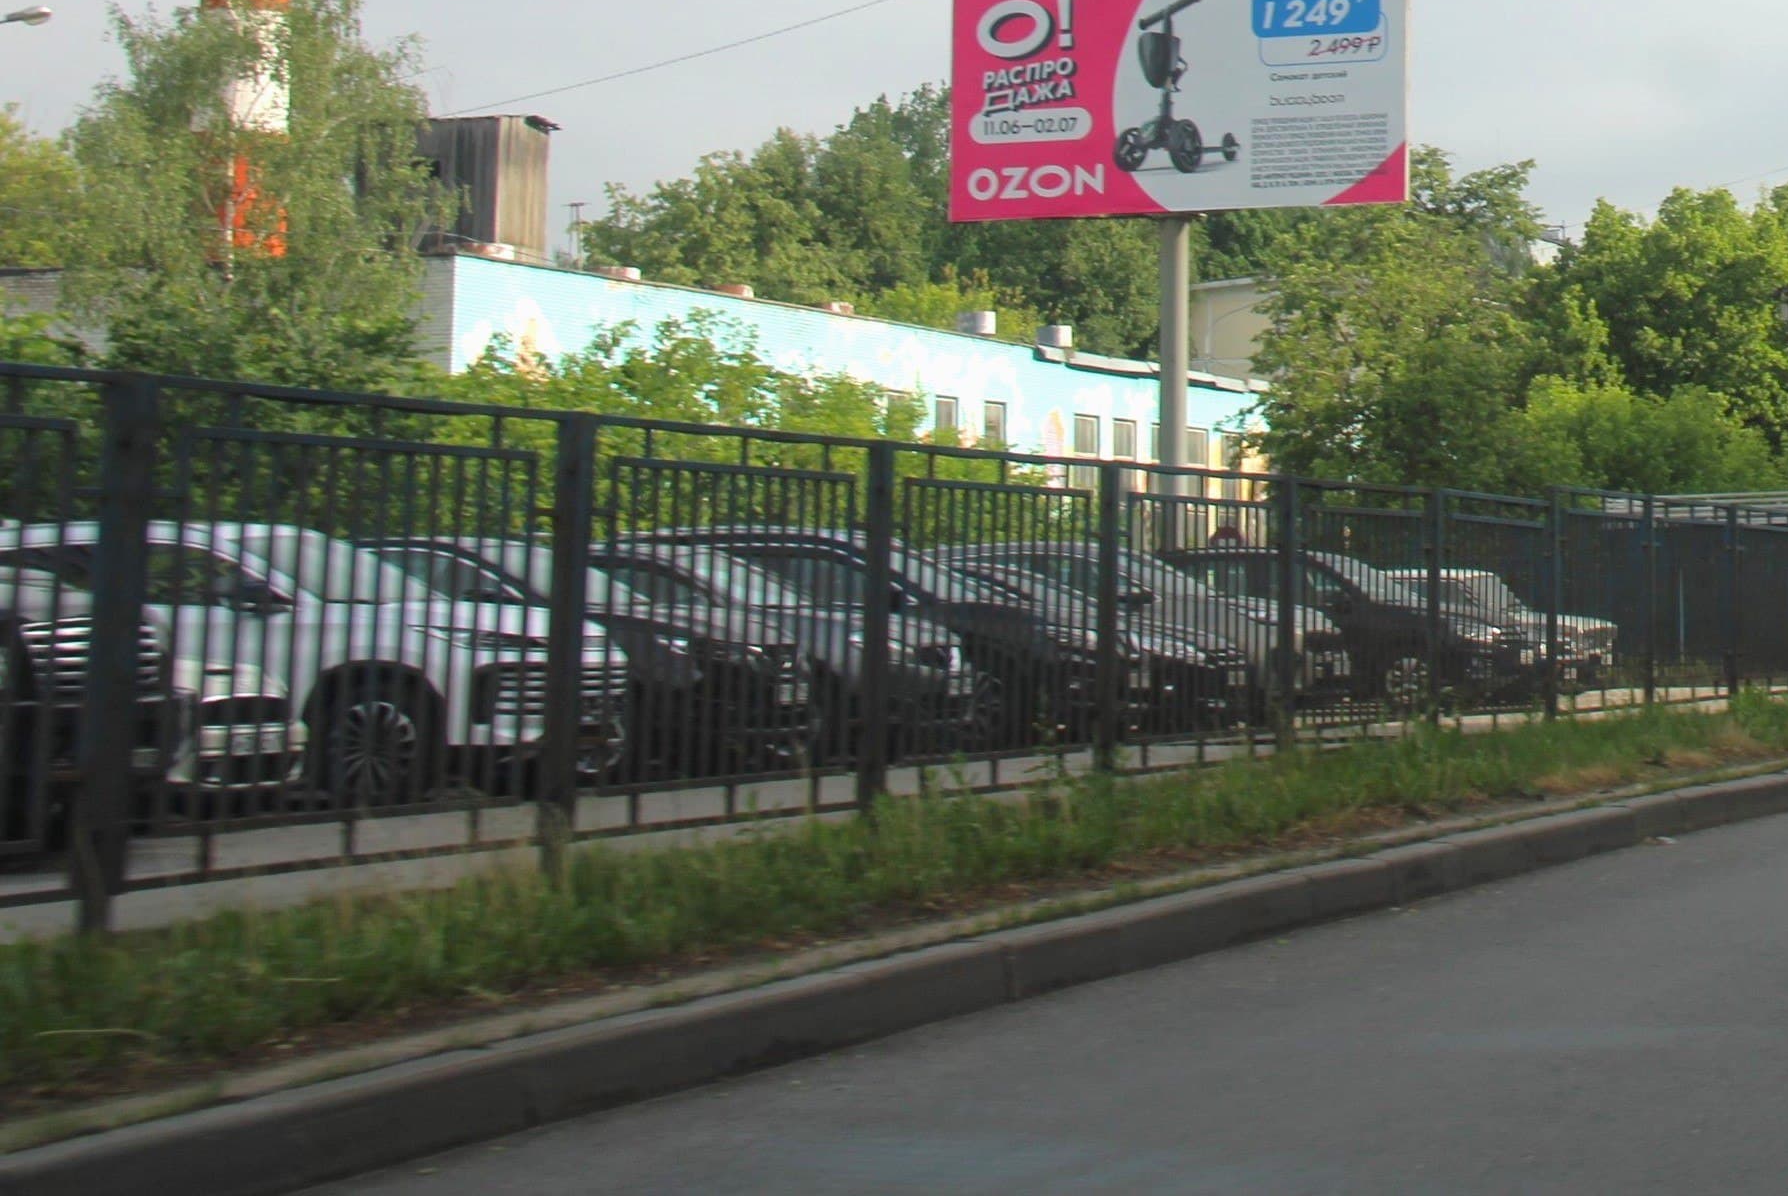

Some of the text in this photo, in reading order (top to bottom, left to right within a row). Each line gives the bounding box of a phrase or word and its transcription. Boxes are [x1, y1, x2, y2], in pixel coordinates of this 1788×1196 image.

[983, 57, 1076, 90] РАСПРО
[983, 79, 1076, 115] ДАЖА
[967, 163, 1104, 201] OZON
